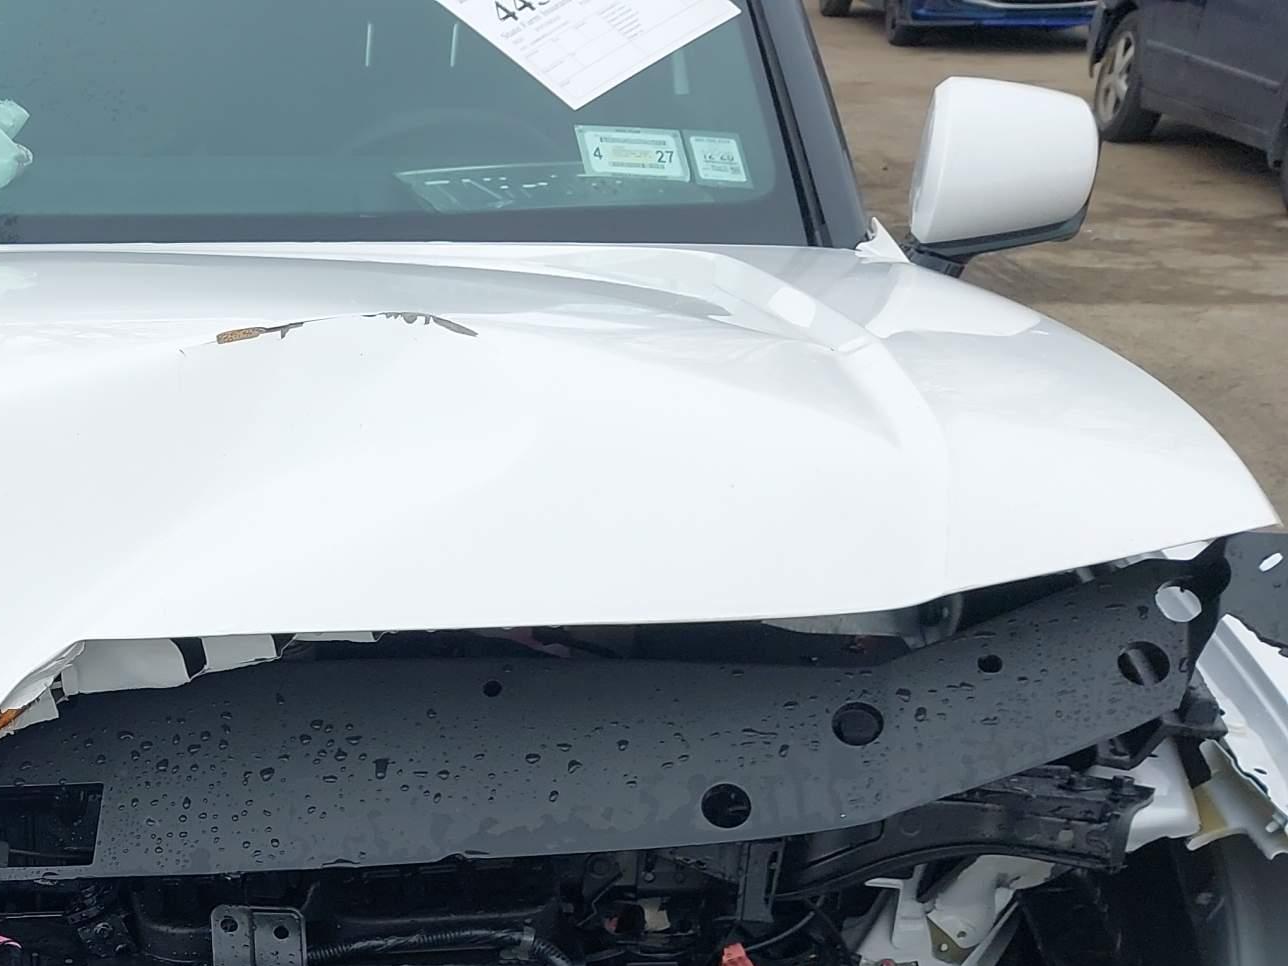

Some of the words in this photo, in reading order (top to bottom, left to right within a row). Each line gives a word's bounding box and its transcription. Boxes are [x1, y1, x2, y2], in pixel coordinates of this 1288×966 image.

[495, 0, 550, 20] 44
[593, 147, 604, 160] 4
[655, 149, 675, 164] 27
